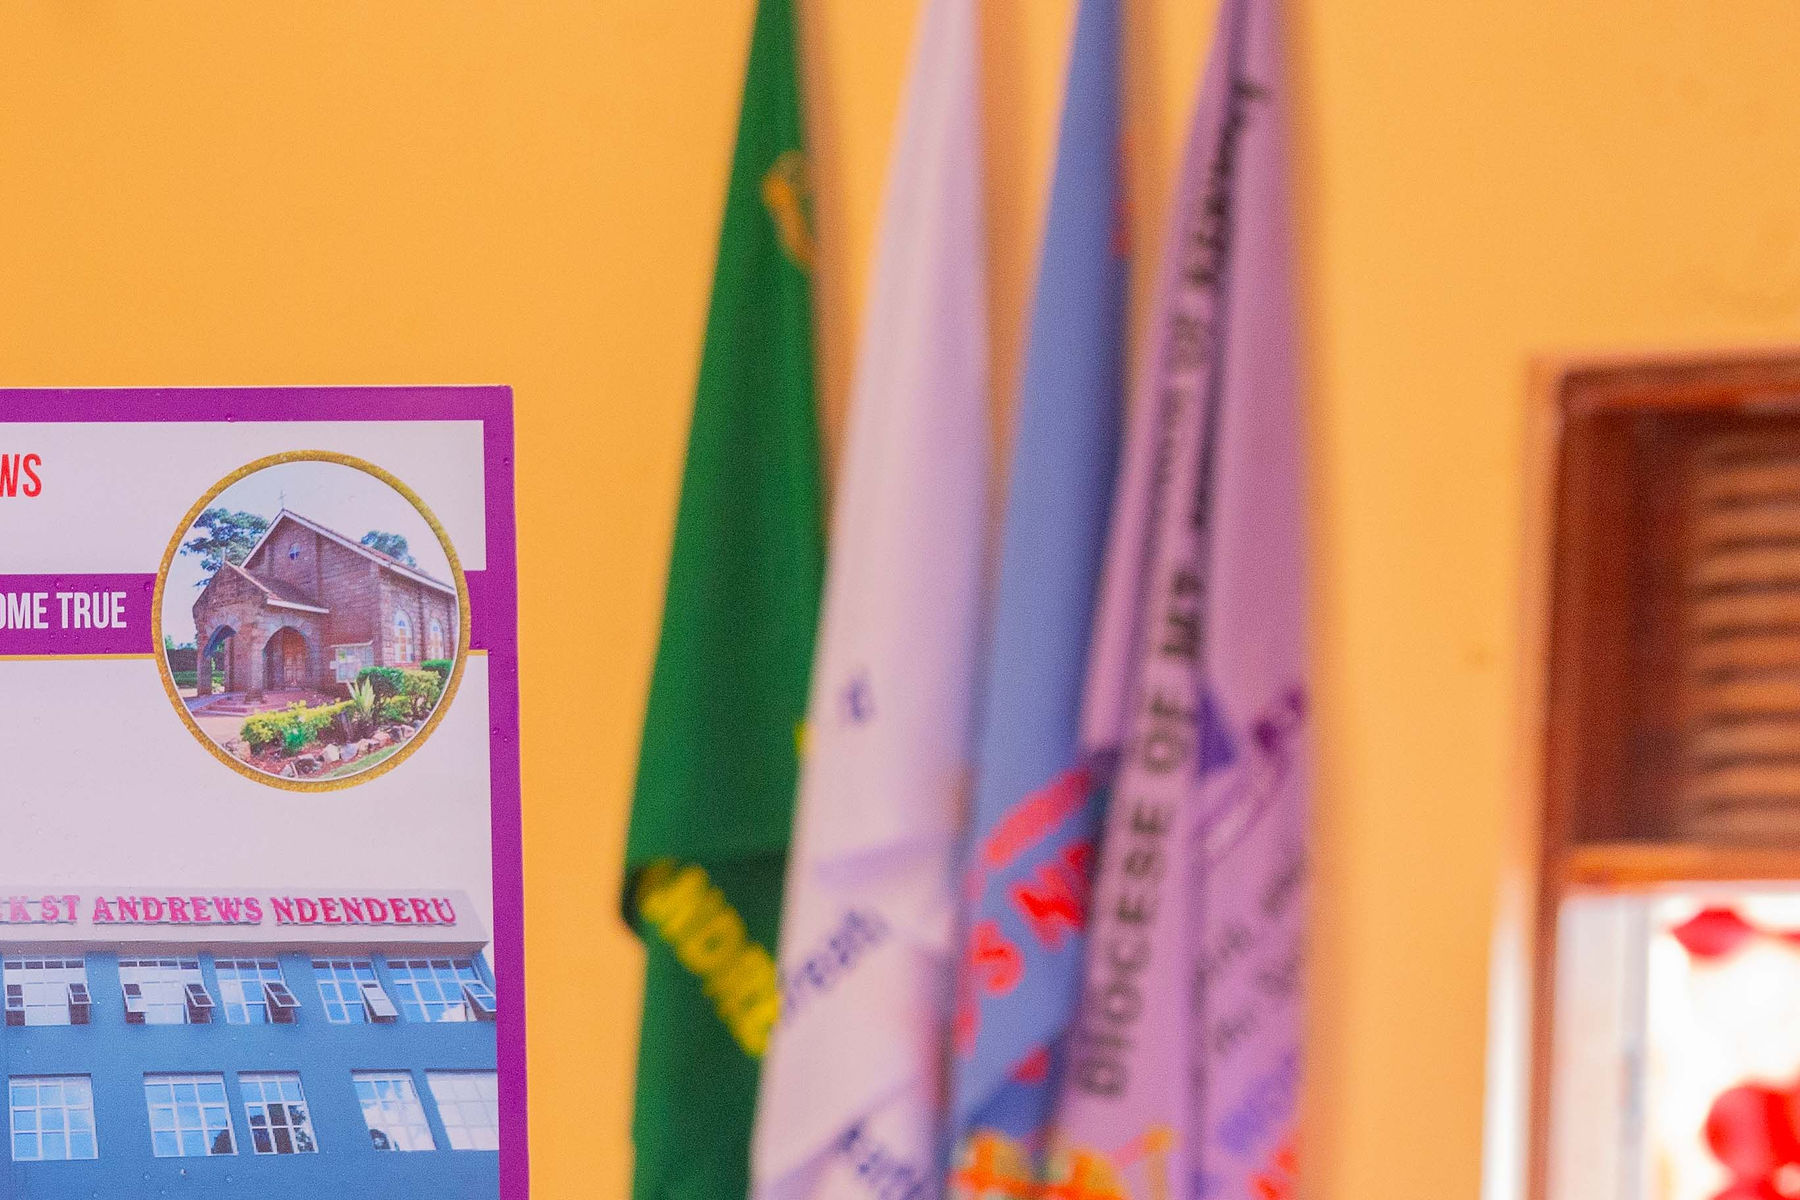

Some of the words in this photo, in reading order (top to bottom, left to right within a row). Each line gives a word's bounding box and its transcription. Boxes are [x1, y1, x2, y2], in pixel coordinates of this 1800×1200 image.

[56, 592, 127, 629] TRUE
[41, 895, 80, 924] ST
[92, 896, 263, 925] ANDREWS
[270, 896, 457, 926] NDENDERU
[1075, 799, 1174, 1099] DIOCESE
